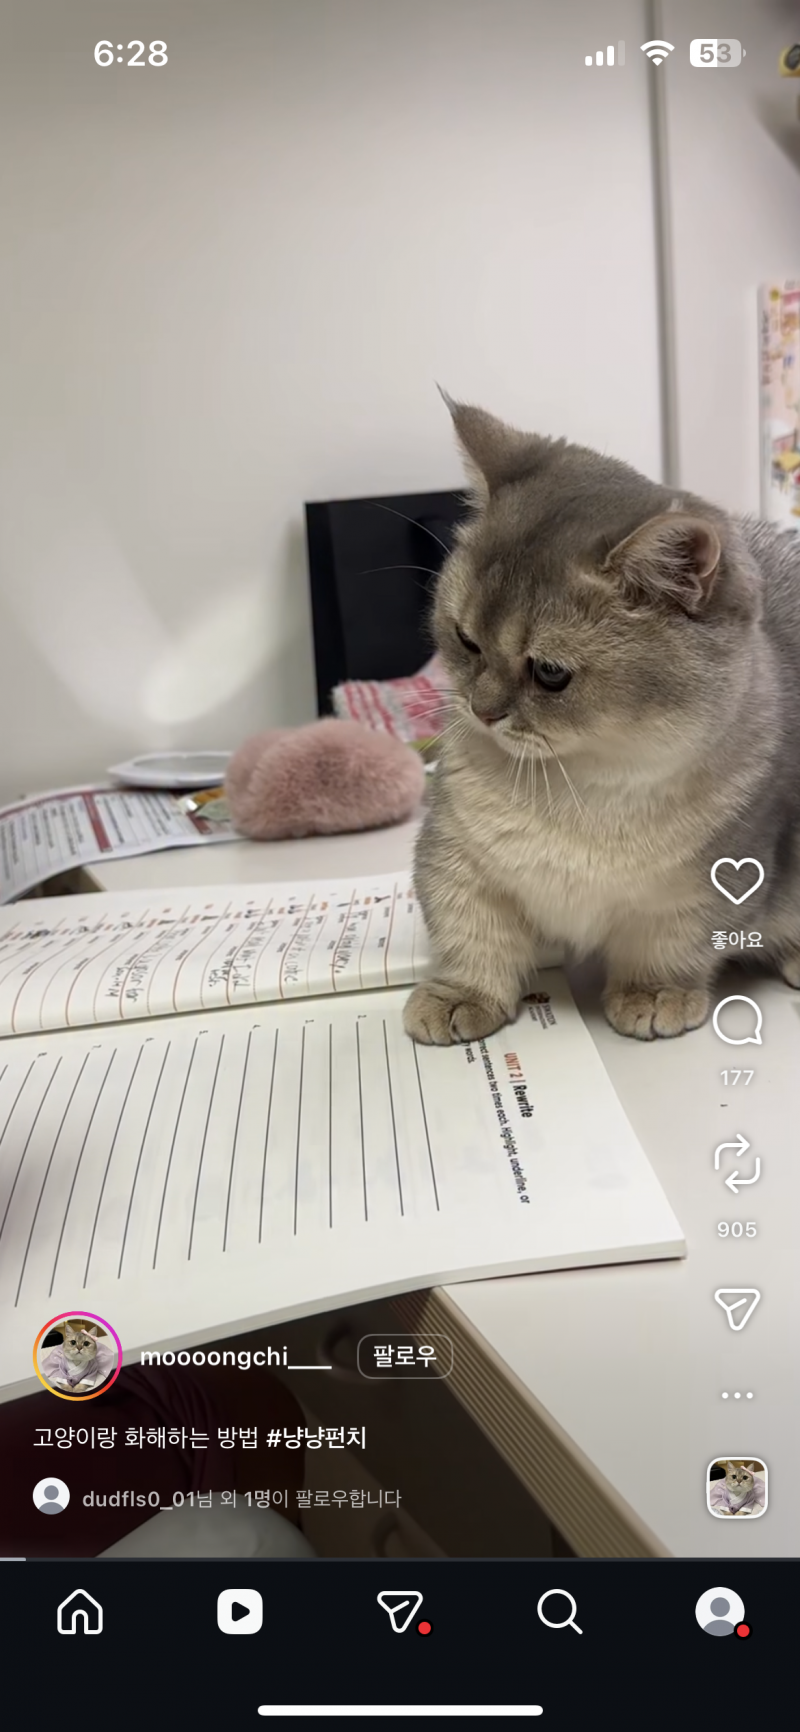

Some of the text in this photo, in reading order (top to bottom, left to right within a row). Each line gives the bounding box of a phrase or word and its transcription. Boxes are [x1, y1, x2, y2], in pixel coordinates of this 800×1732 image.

[482, 1054, 495, 1080] sentences
[489, 1081, 498, 1092] two
[504, 1052, 521, 1070] UNIT
[513, 1085, 534, 1118] Rewrite
[492, 1092, 503, 1109] times
[496, 1109, 510, 1126] each.
[500, 1127, 518, 1157] Highlight,
[510, 1158, 527, 1194] underline,
[520, 1195, 530, 1204] or
